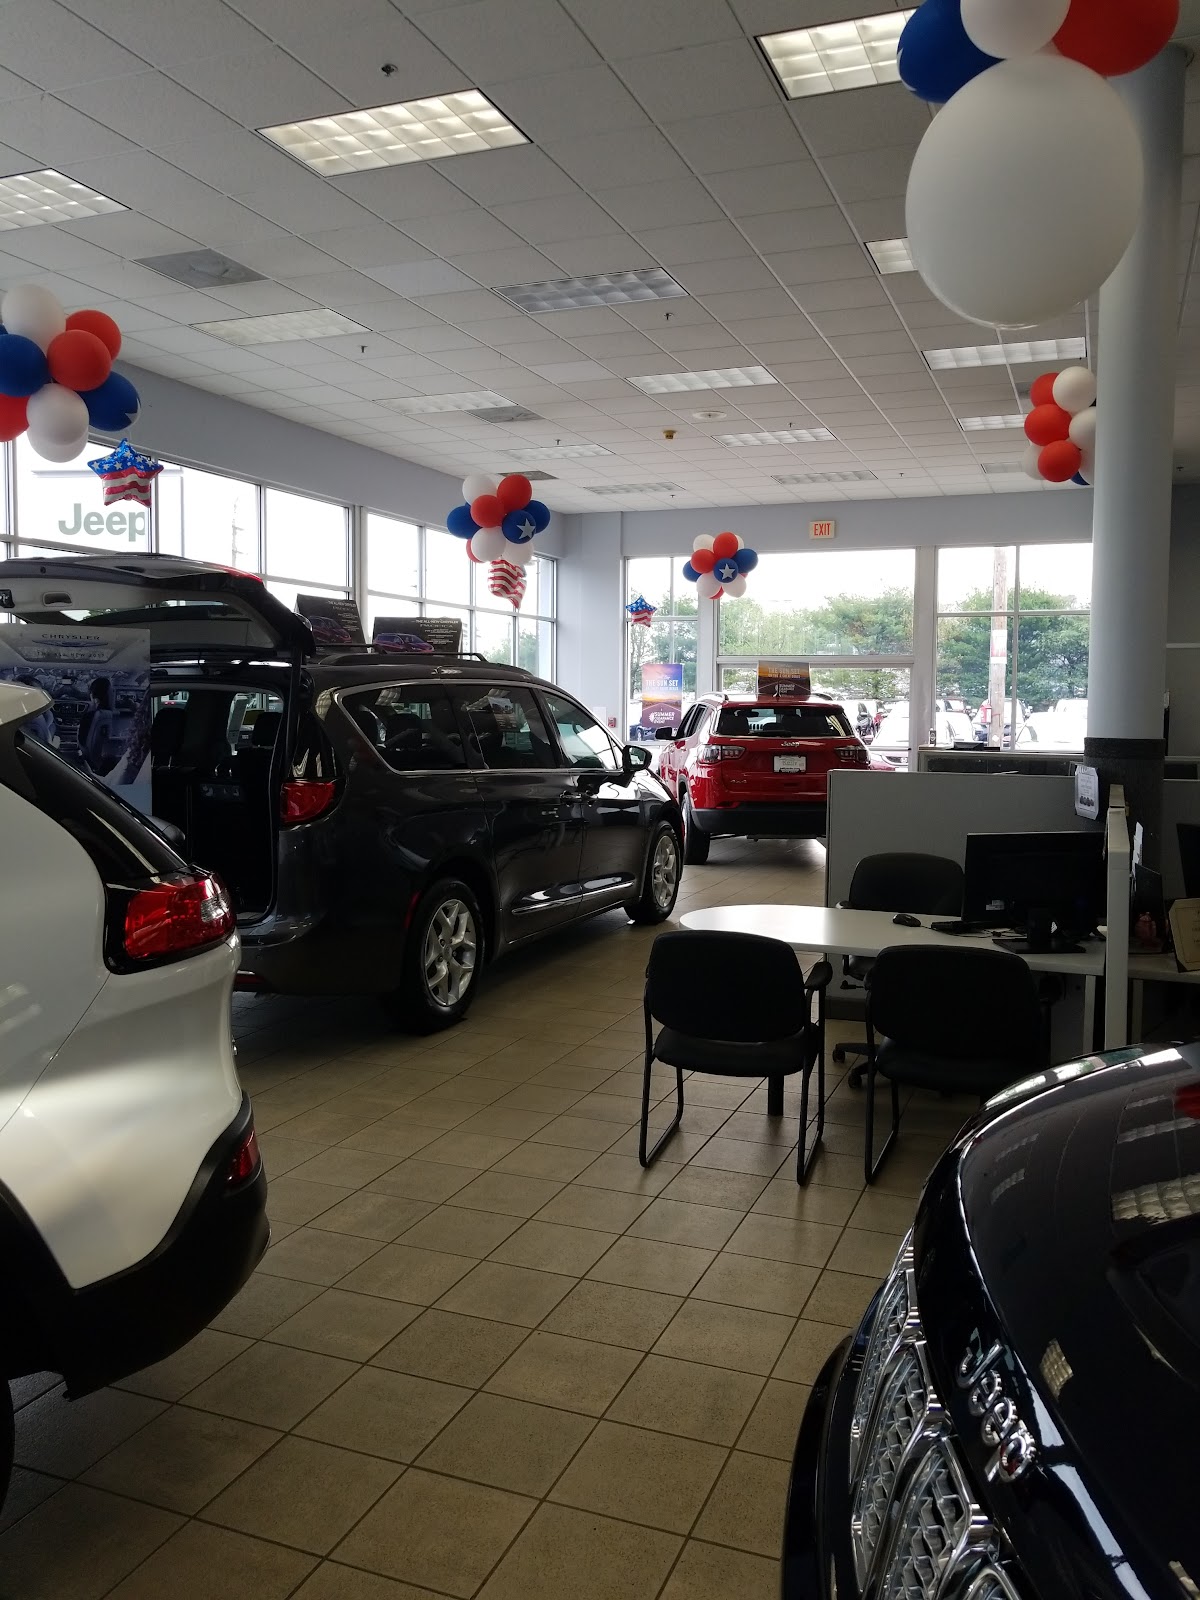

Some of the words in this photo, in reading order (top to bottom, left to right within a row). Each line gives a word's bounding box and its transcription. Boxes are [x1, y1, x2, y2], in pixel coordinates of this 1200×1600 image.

[58, 503, 146, 542] Jeep
[814, 523, 831, 536] EXIT
[41, 633, 100, 641] CHRYSLER
[956, 1338, 1037, 1482] Jeep
